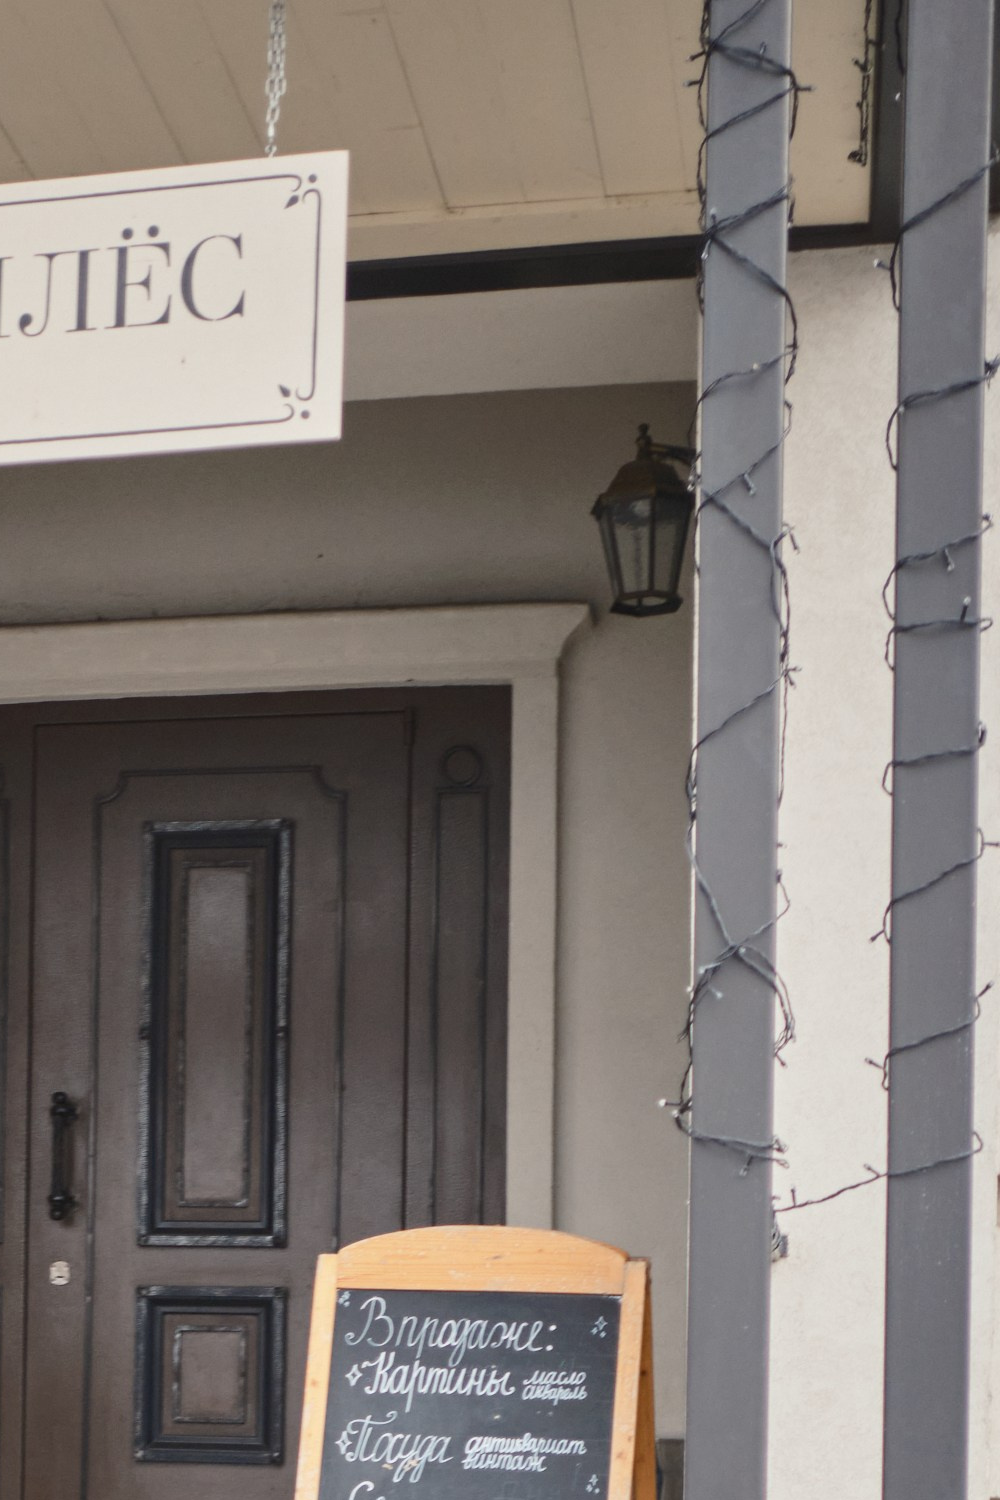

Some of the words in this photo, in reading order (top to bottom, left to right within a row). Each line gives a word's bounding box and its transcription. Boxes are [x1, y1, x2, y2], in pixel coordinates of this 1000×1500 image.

[361, 1351, 516, 1413] Картины
[522, 1369, 587, 1386] масло
[521, 1384, 588, 1407] акварель
[345, 1410, 454, 1483] Посуда
[464, 1432, 588, 1456] антиквариат
